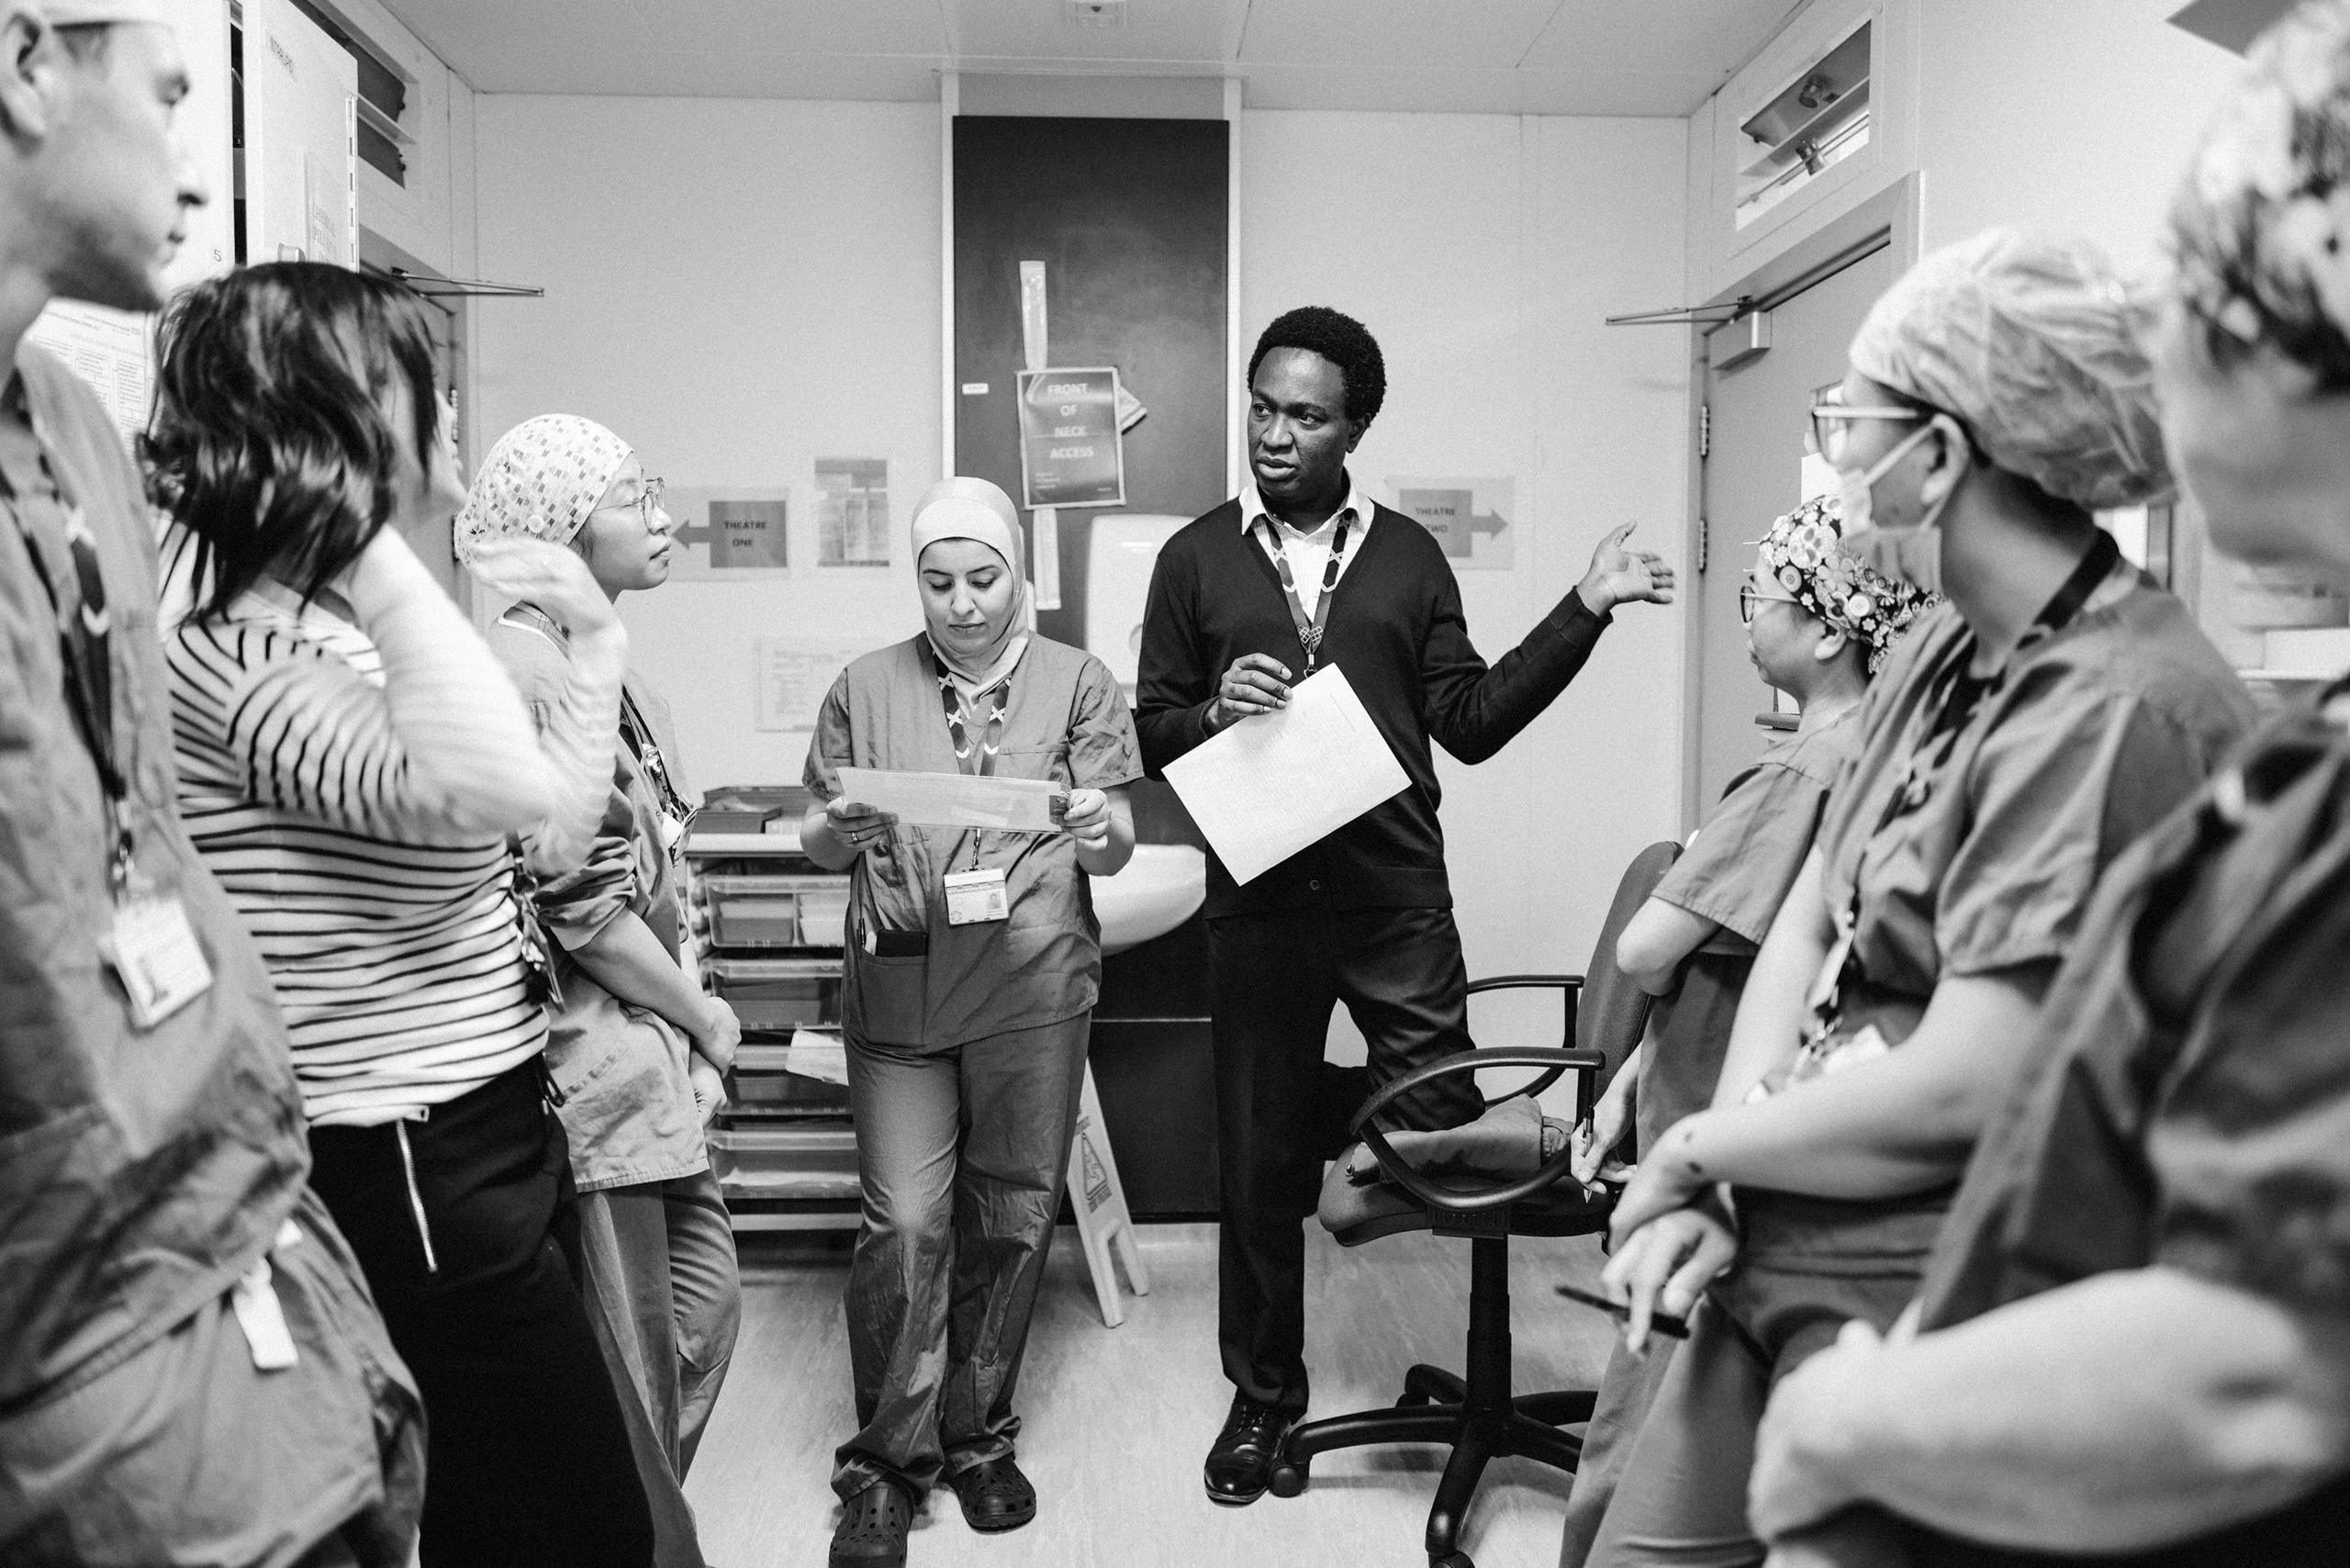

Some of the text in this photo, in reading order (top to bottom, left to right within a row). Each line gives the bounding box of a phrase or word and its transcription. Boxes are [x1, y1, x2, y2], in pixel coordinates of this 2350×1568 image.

[213, 249, 222, 263] 5
[1047, 383, 1089, 395] FRONT
[1060, 404, 1078, 417] OF
[1049, 446, 1095, 459] ACCESS
[1415, 507, 1455, 515] THEATRE
[724, 521, 767, 531] THEATRE
[733, 538, 754, 547] ONE
